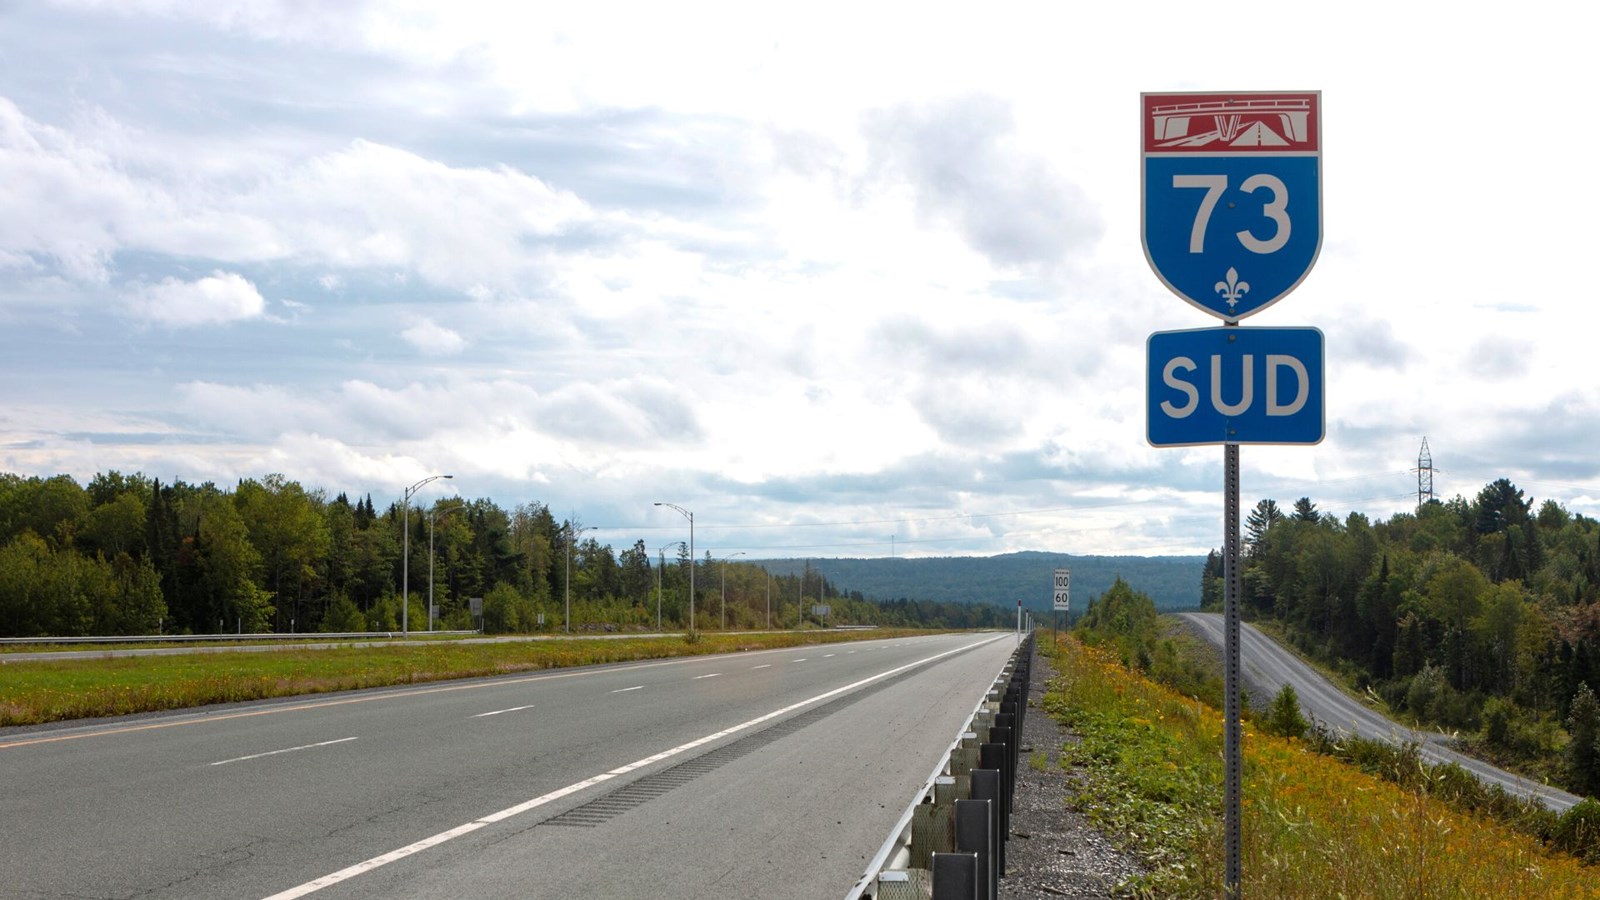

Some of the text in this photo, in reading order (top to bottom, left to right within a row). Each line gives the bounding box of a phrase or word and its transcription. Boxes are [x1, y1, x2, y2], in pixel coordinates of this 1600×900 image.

[1172, 174, 1292, 255] 73
[1160, 354, 1310, 419] SUD
[1055, 576, 1068, 587] 100
[1055, 593, 1068, 603] 60
